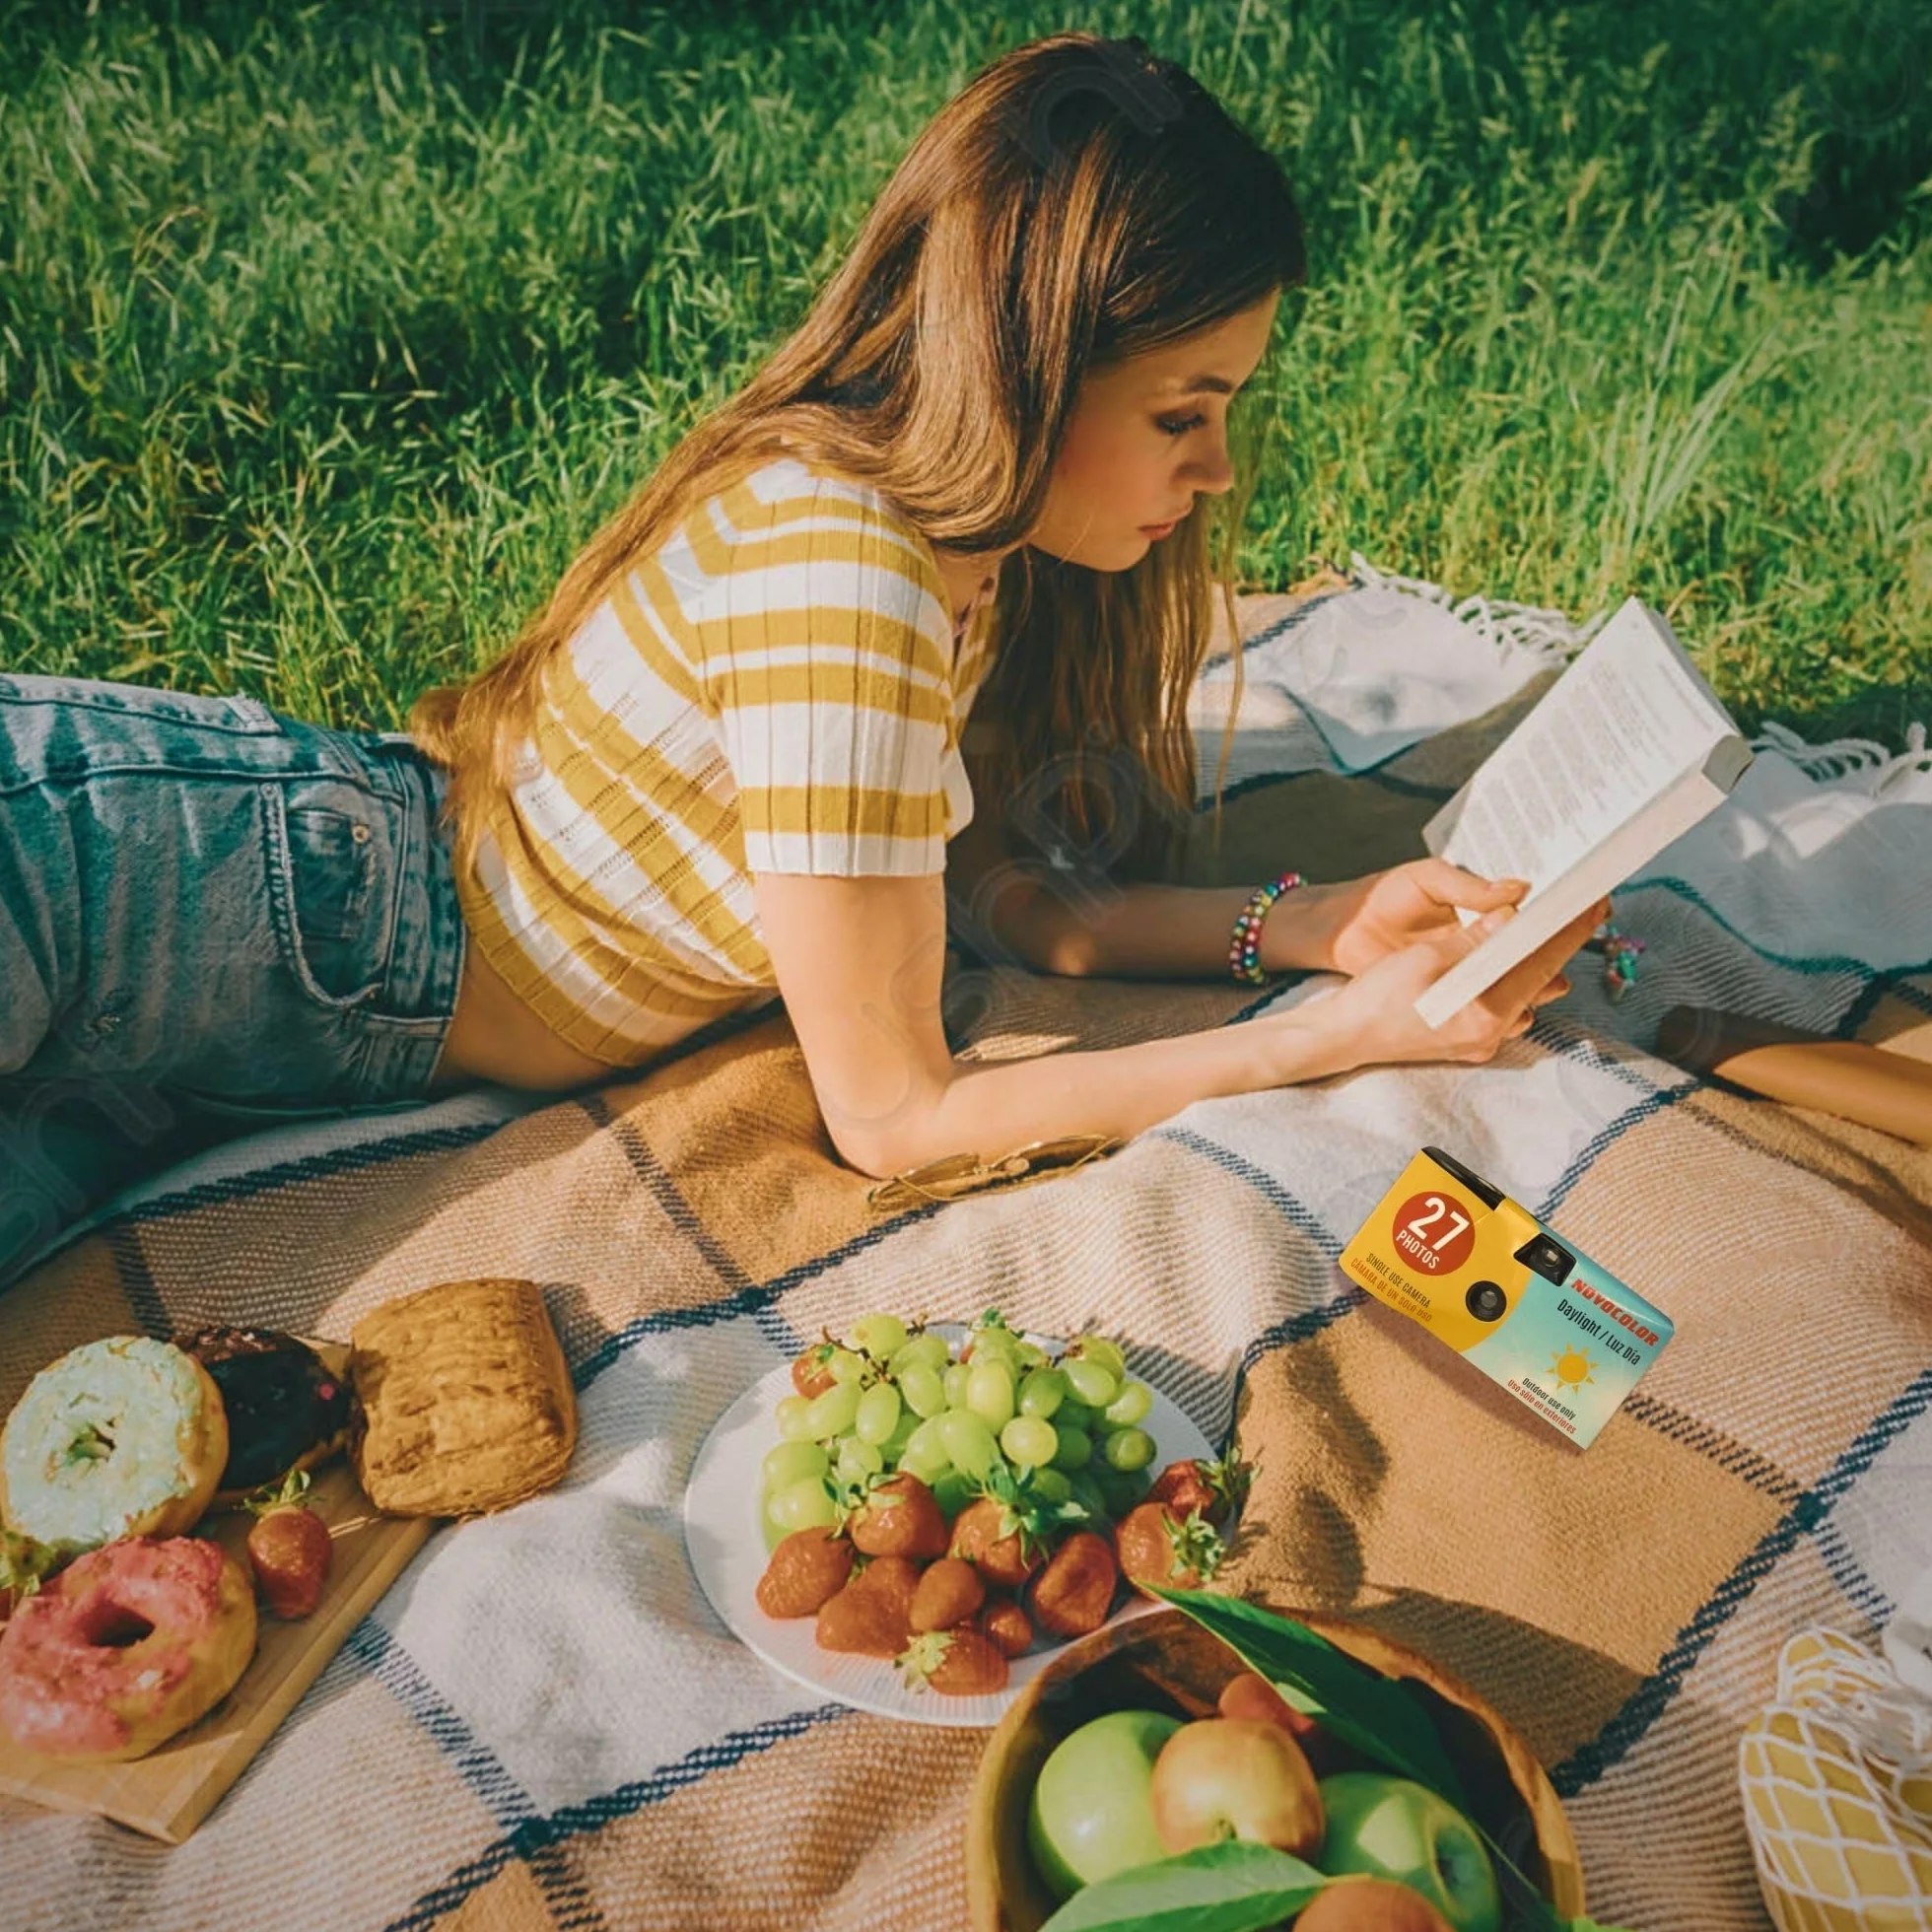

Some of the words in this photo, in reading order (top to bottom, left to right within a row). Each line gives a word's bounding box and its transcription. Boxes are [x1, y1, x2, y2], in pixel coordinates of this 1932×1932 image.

[1396, 1229, 1439, 1269] PHOTOS
[1408, 1197, 1470, 1251] 27
[1351, 1258, 1377, 1285] CÁMARA
[1377, 1280, 1388, 1292] DE
[1387, 1288, 1399, 1300] UN
[1399, 1297, 1416, 1312] SOLO
[1417, 1309, 1432, 1321] USO
[1366, 1253, 1390, 1276] SINGLE
[1389, 1272, 1403, 1286] USE
[1402, 1283, 1431, 1308] CAMERA
[1557, 1299, 1602, 1337] Daylight
[1598, 1331, 1609, 1340] /
[1605, 1335, 1624, 1353] Luz
[1622, 1346, 1640, 1365] Día
[1571, 1278, 1659, 1346] NOVOCOLOR
[1508, 1379, 1520, 1392] Uso
[1534, 1401, 1544, 1410] en
[1544, 1408, 1576, 1434] exteriores
[1522, 1378, 1550, 1400] Outdoor
[1548, 1398, 1561, 1409] use
[1560, 1407, 1576, 1420] only
